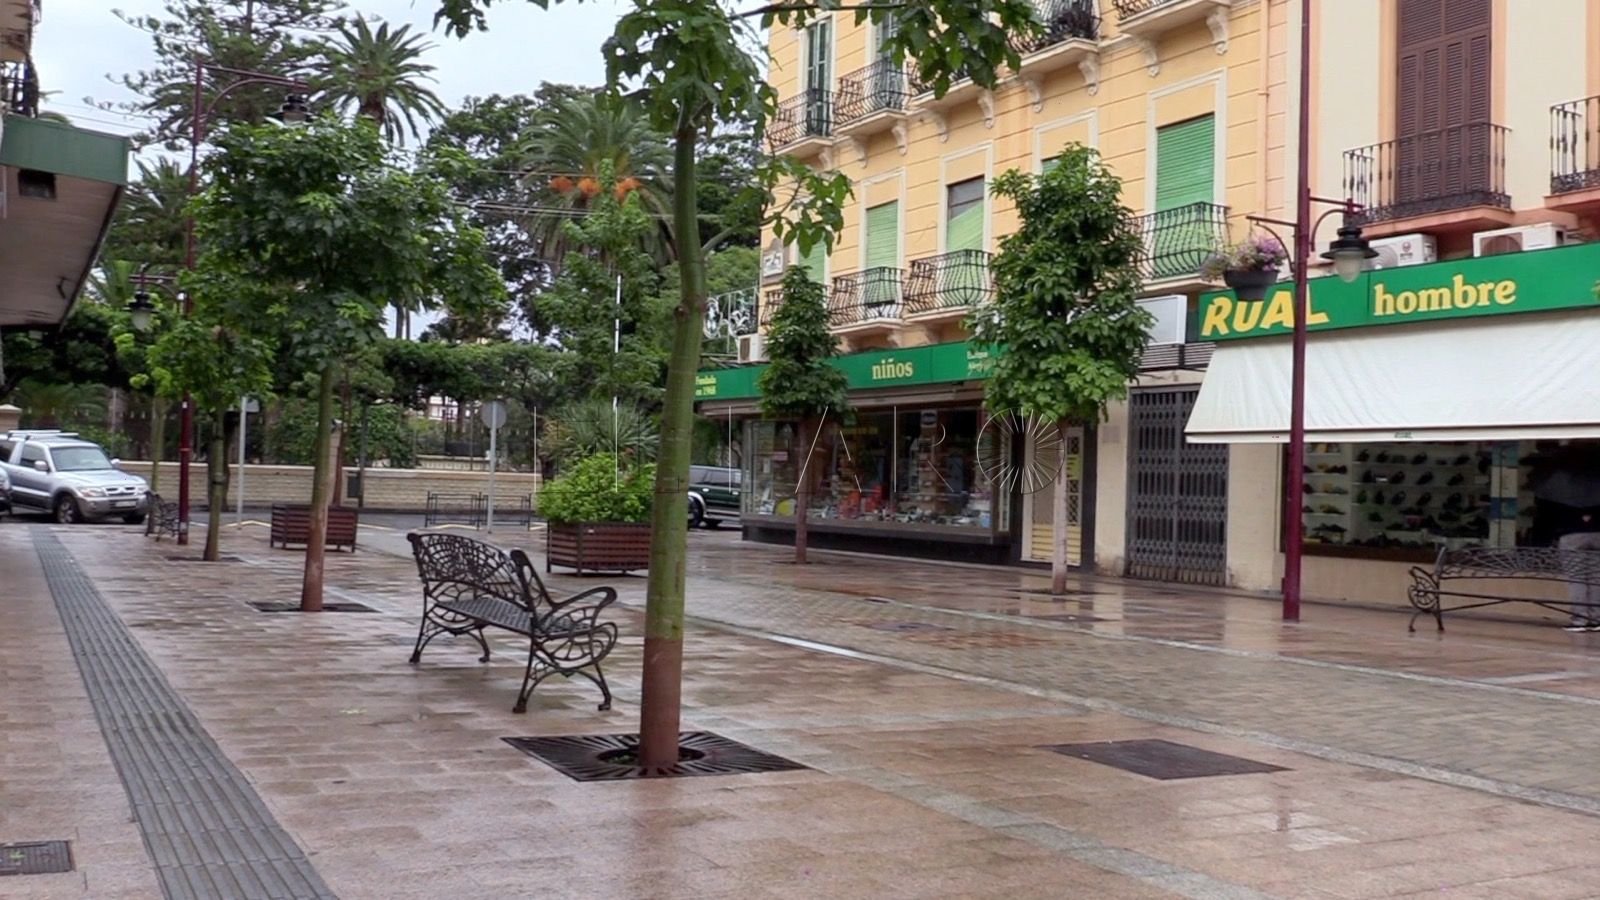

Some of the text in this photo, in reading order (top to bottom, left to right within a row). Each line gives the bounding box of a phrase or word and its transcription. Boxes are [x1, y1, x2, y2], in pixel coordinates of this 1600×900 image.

[1201, 284, 1330, 336] RUAL
[1374, 274, 1516, 317] hombre
[872, 358, 913, 380] niños
